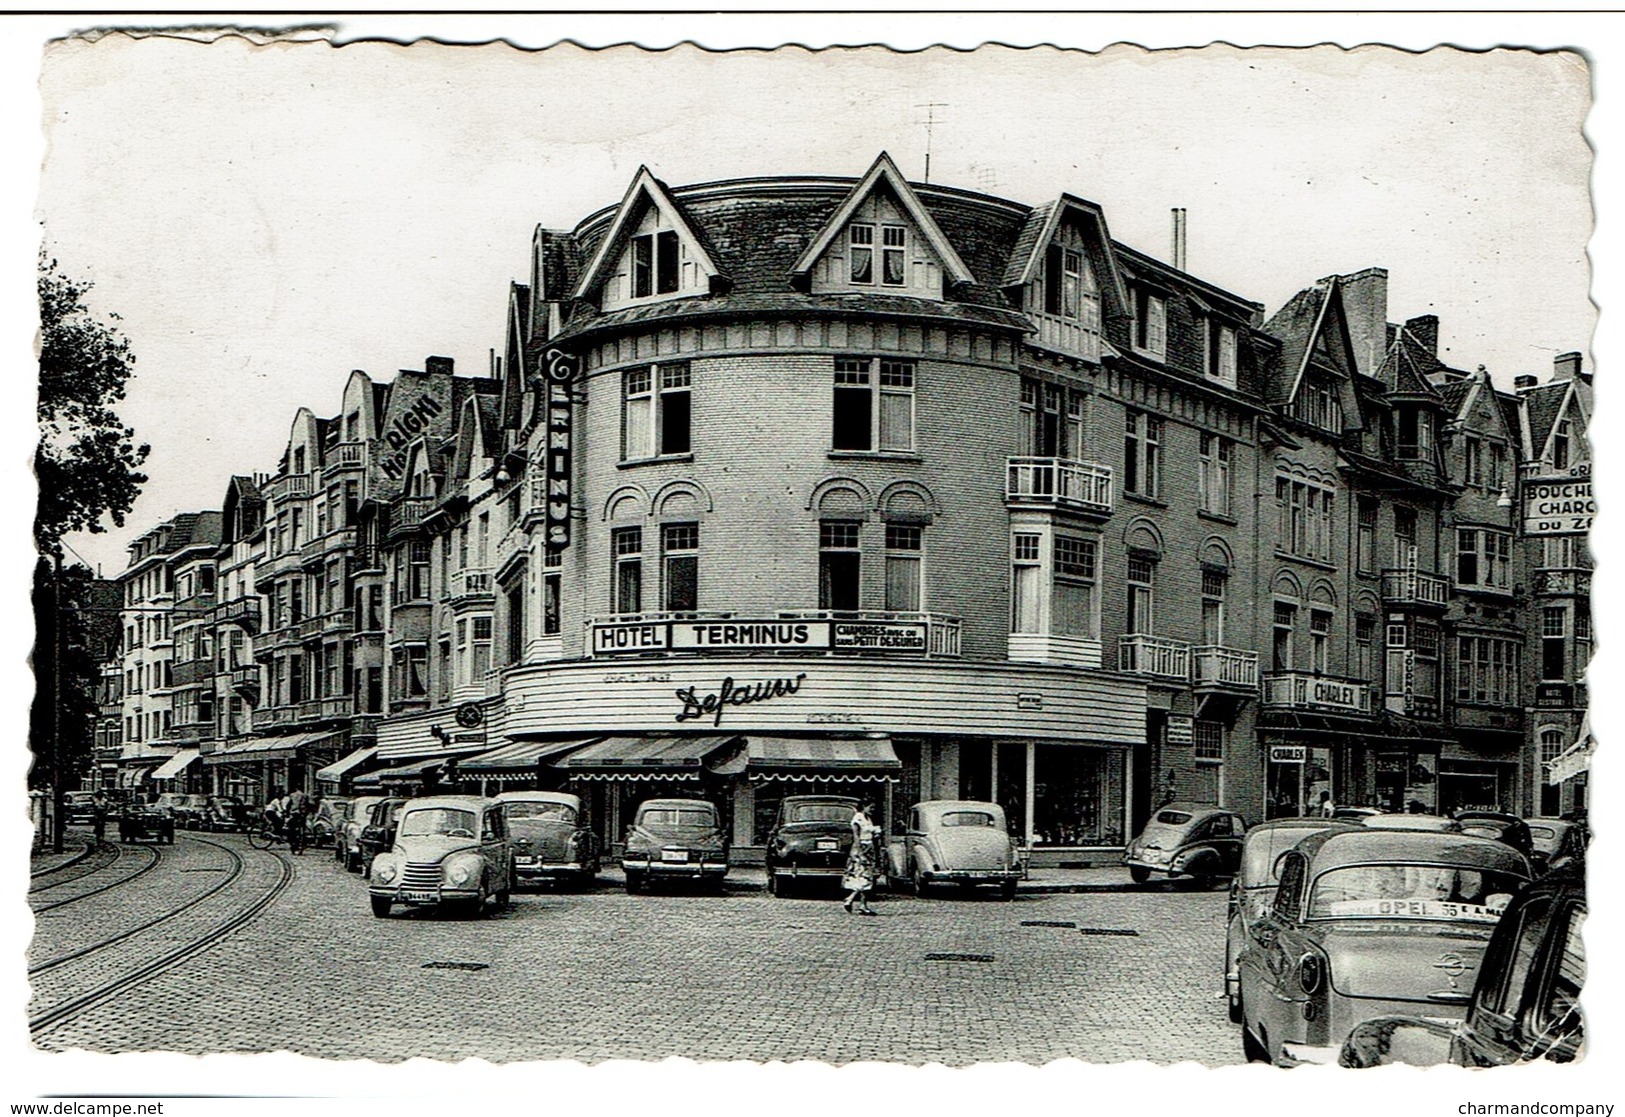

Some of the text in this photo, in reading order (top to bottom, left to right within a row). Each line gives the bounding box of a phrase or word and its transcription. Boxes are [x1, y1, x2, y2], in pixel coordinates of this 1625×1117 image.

[547, 348, 577, 543] TERMINUS
[1539, 521, 1561, 530] DU
[602, 625, 809, 648] HOTEL TERMINUS
[837, 625, 886, 636] CHAMBRES
[854, 636, 878, 646] PETIT
[1404, 650, 1414, 710] JOURNAUX
[1314, 682, 1355, 706] CHARLEX
[1379, 902, 1433, 915] OPEL
